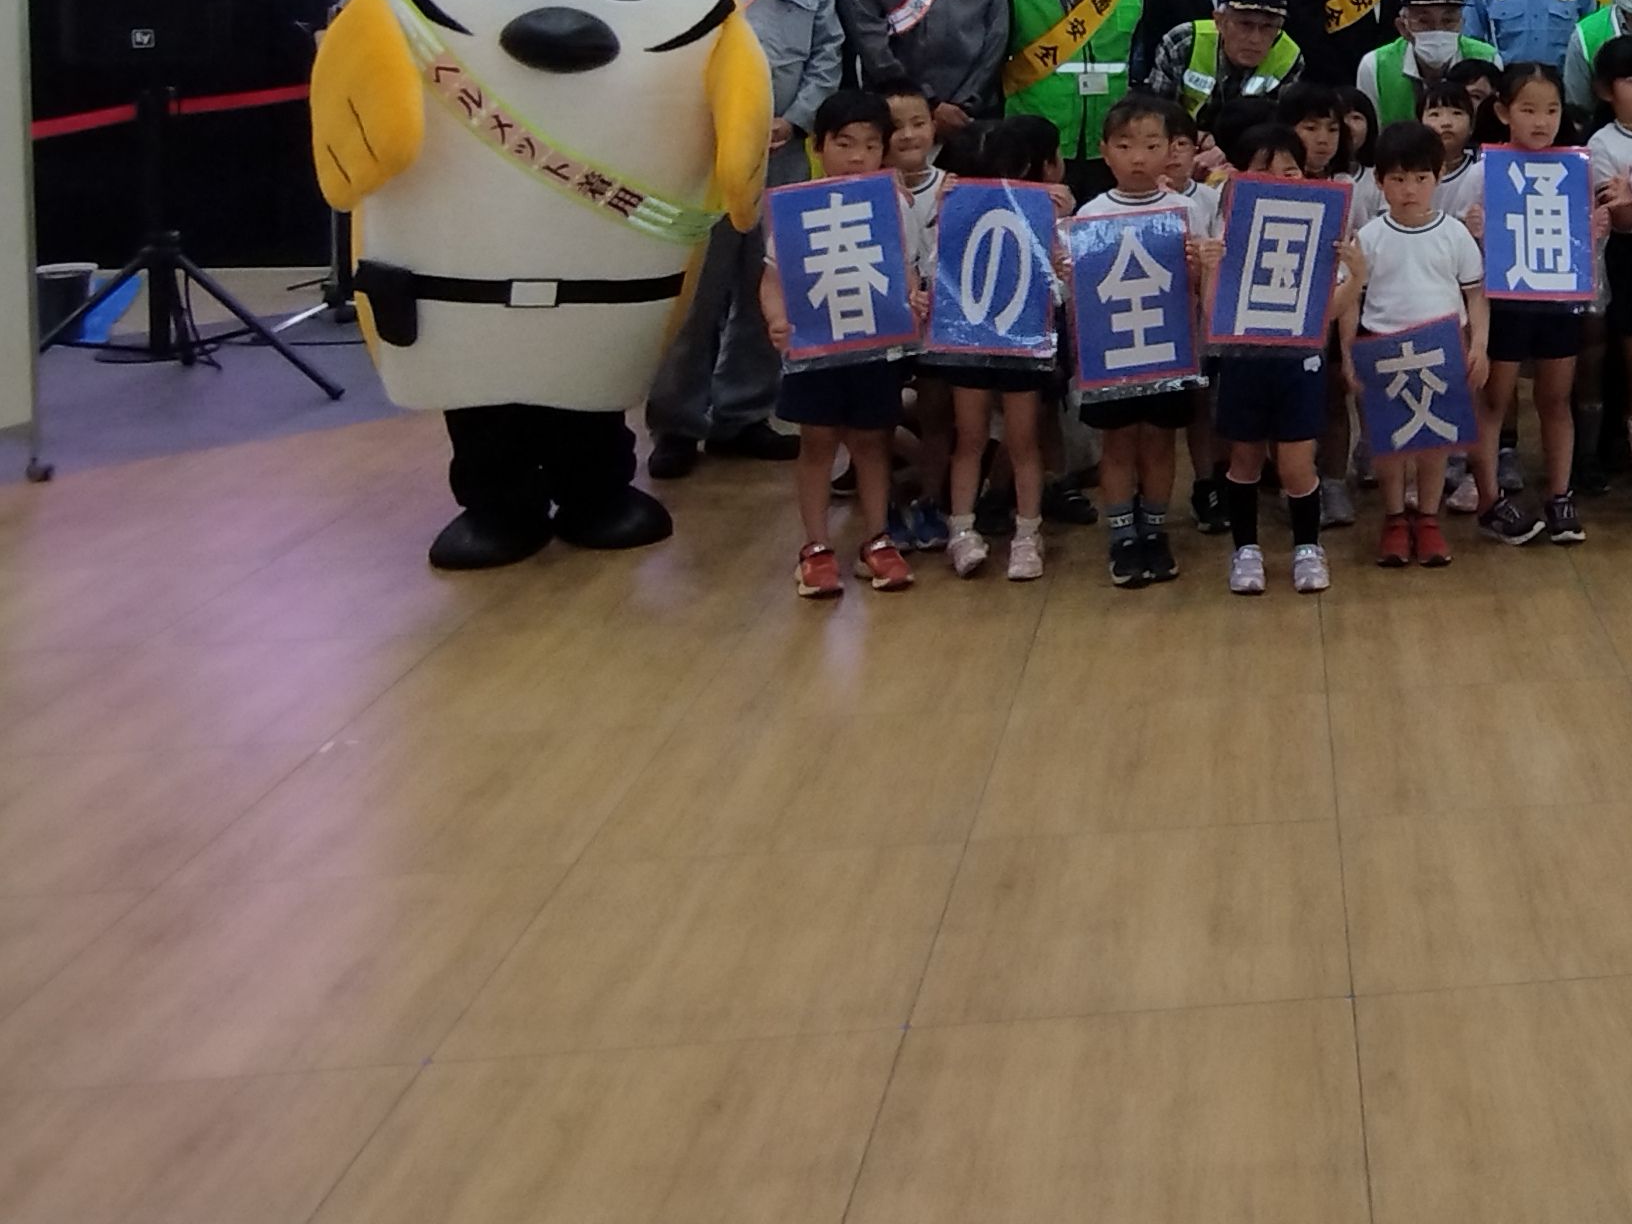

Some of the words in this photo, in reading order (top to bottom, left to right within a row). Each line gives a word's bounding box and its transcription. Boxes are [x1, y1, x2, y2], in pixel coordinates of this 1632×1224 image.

[432, 64, 644, 218] ヘルメット着用
[801, 192, 889, 342] 春
[960, 207, 1033, 337] の
[1233, 197, 1326, 337] 国
[1505, 160, 1578, 292] 通
[1096, 226, 1173, 371] 全
[1375, 340, 1460, 450] 交
